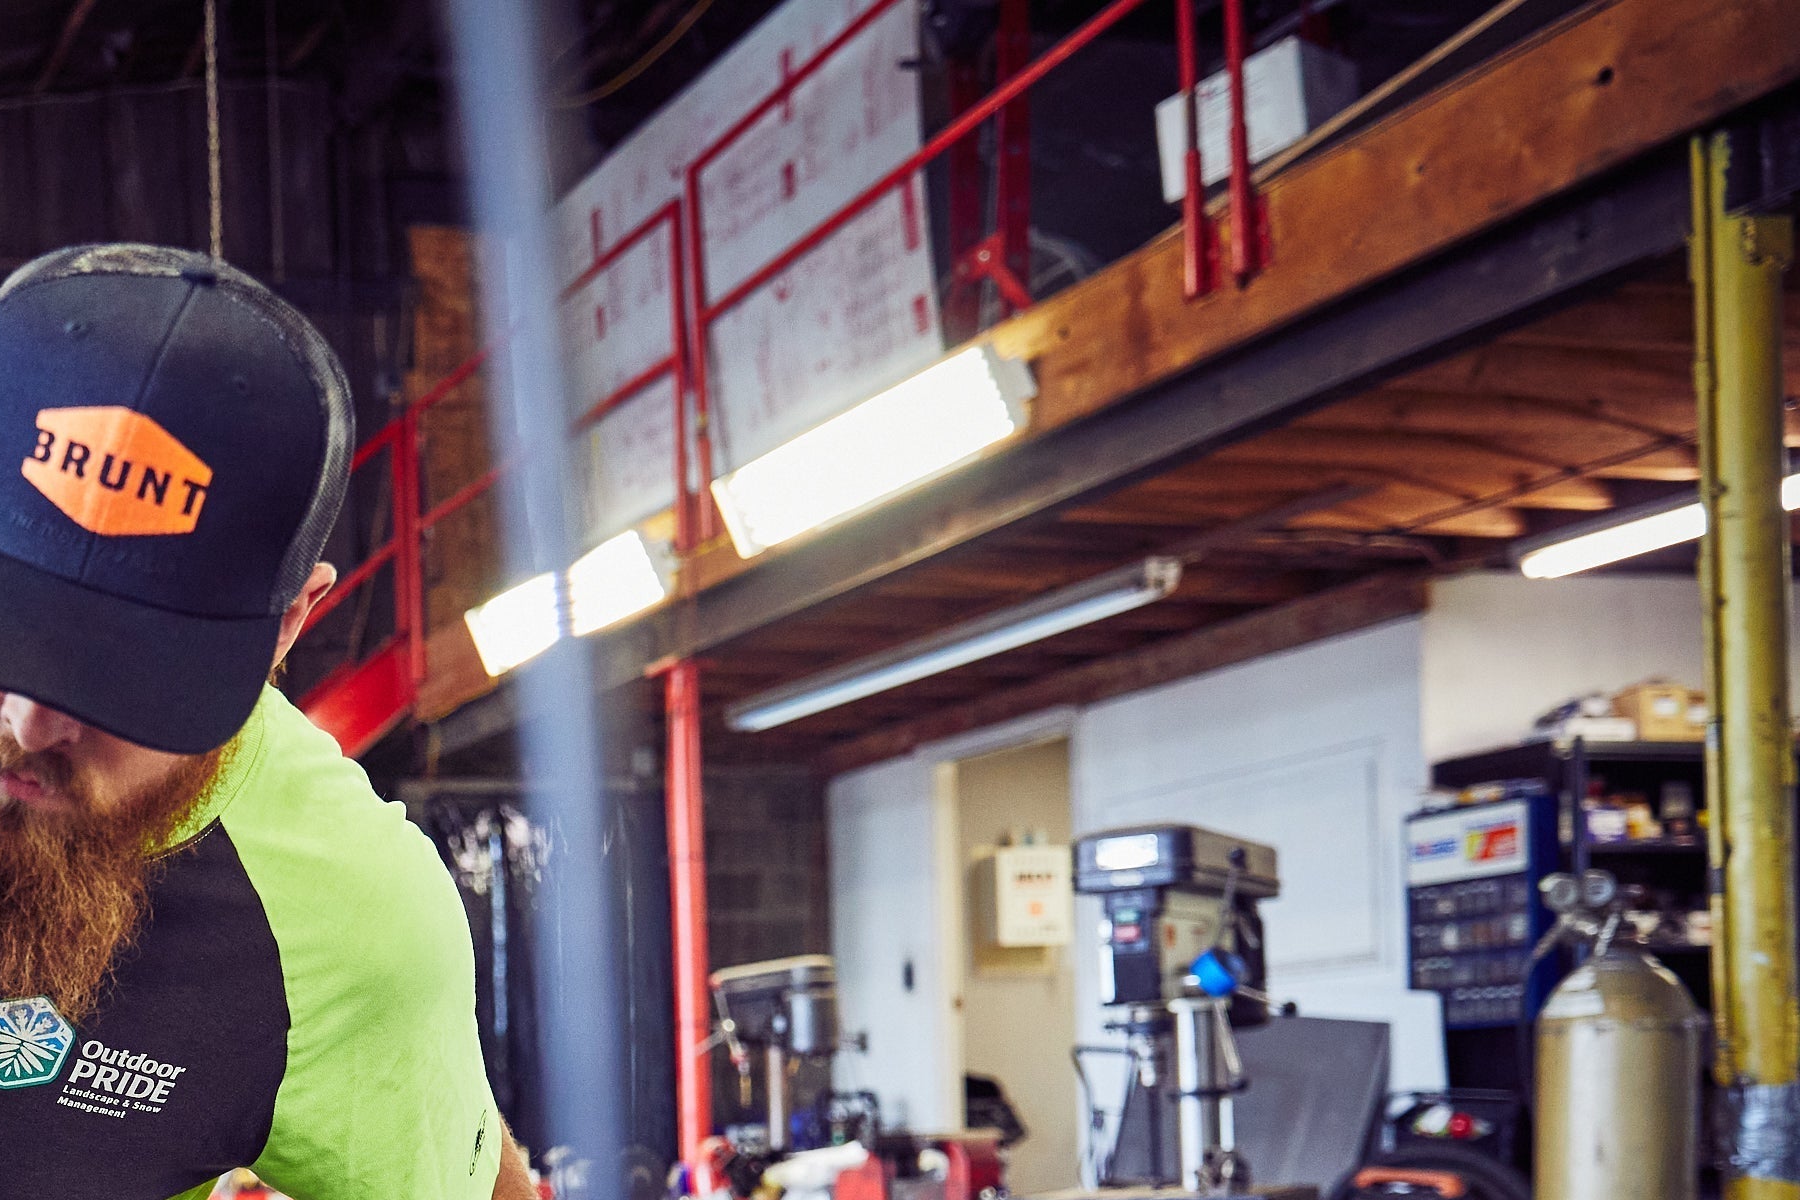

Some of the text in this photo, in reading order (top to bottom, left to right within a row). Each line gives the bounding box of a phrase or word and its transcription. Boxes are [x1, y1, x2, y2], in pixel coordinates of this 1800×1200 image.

[32, 429, 208, 516] BRUNT
[81, 1040, 186, 1080] Outdoor
[62, 1084, 162, 1114] Landscape & Snow
[67, 1058, 176, 1104] PRIDE
[56, 1096, 127, 1119] Management
